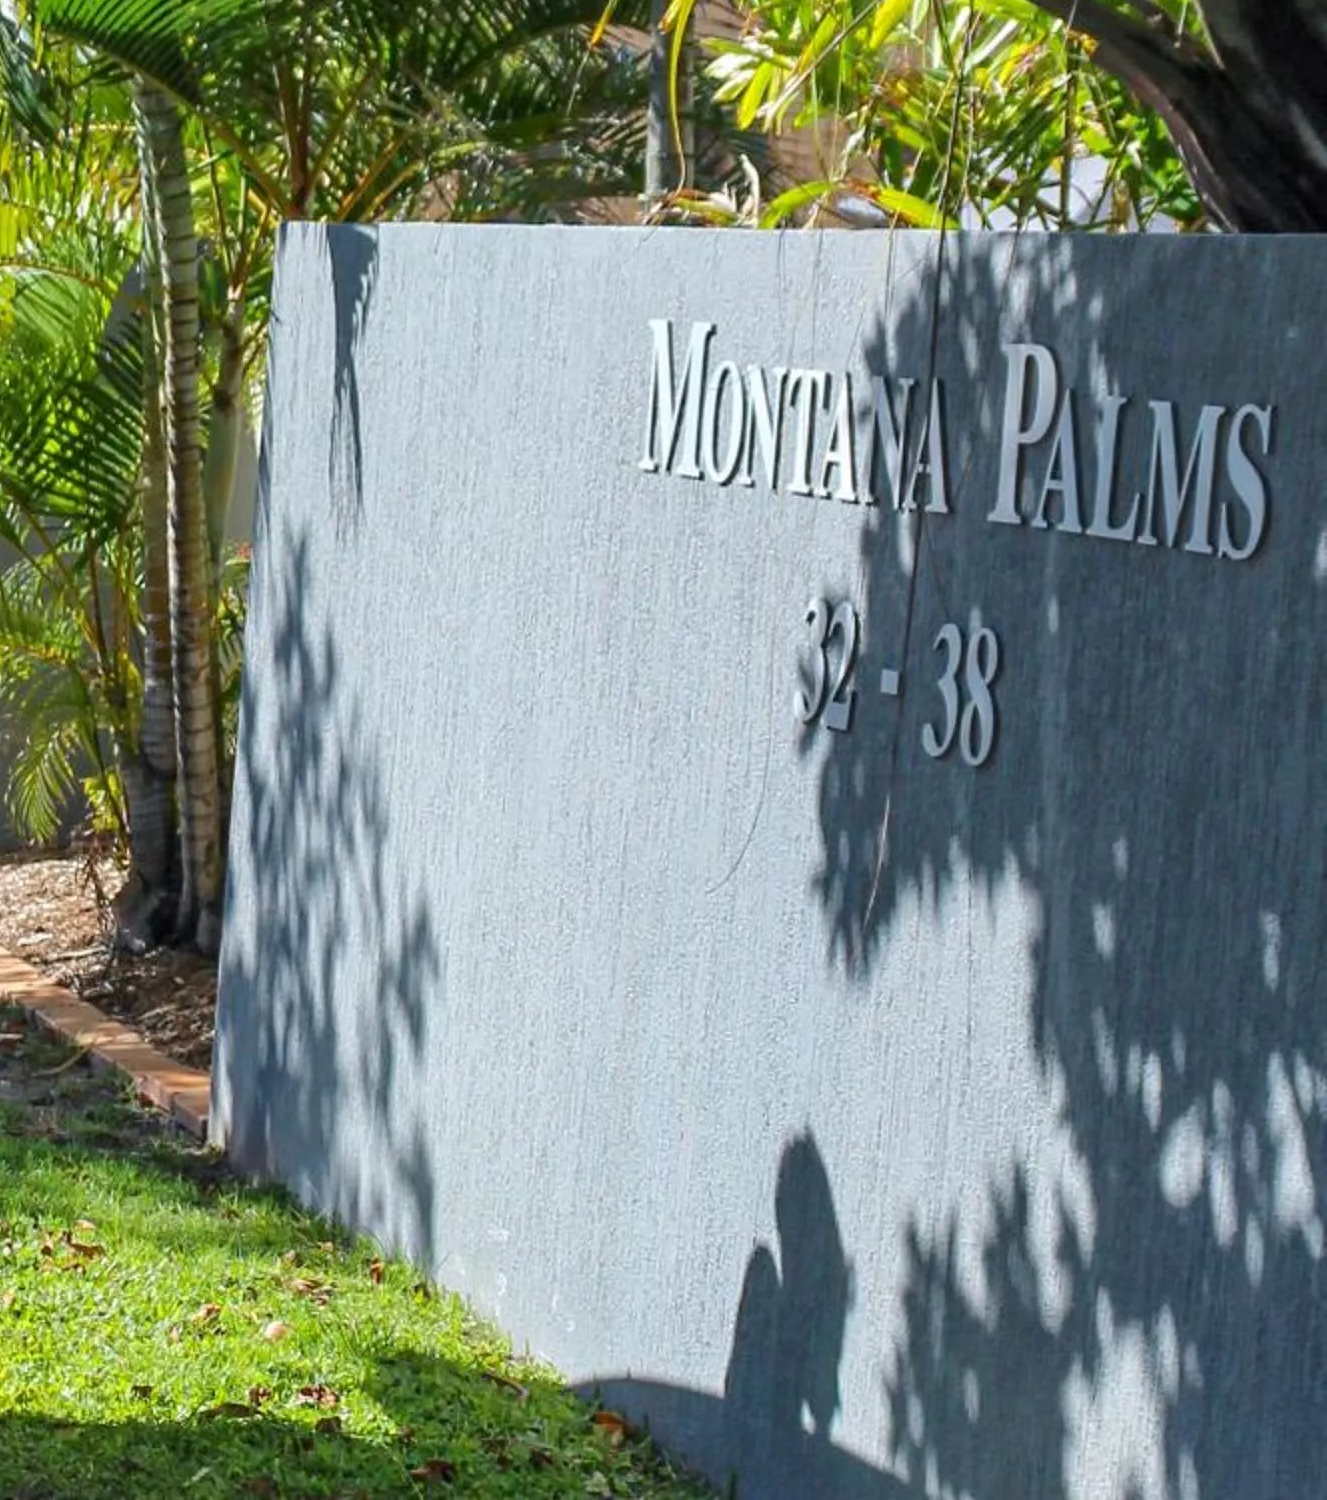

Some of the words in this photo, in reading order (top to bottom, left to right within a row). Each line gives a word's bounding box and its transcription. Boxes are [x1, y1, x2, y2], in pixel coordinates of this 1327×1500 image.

[638, 319, 951, 513] MONTANA
[987, 343, 1277, 560] PALMS
[794, 598, 857, 731] 32
[922, 623, 999, 767] 38
